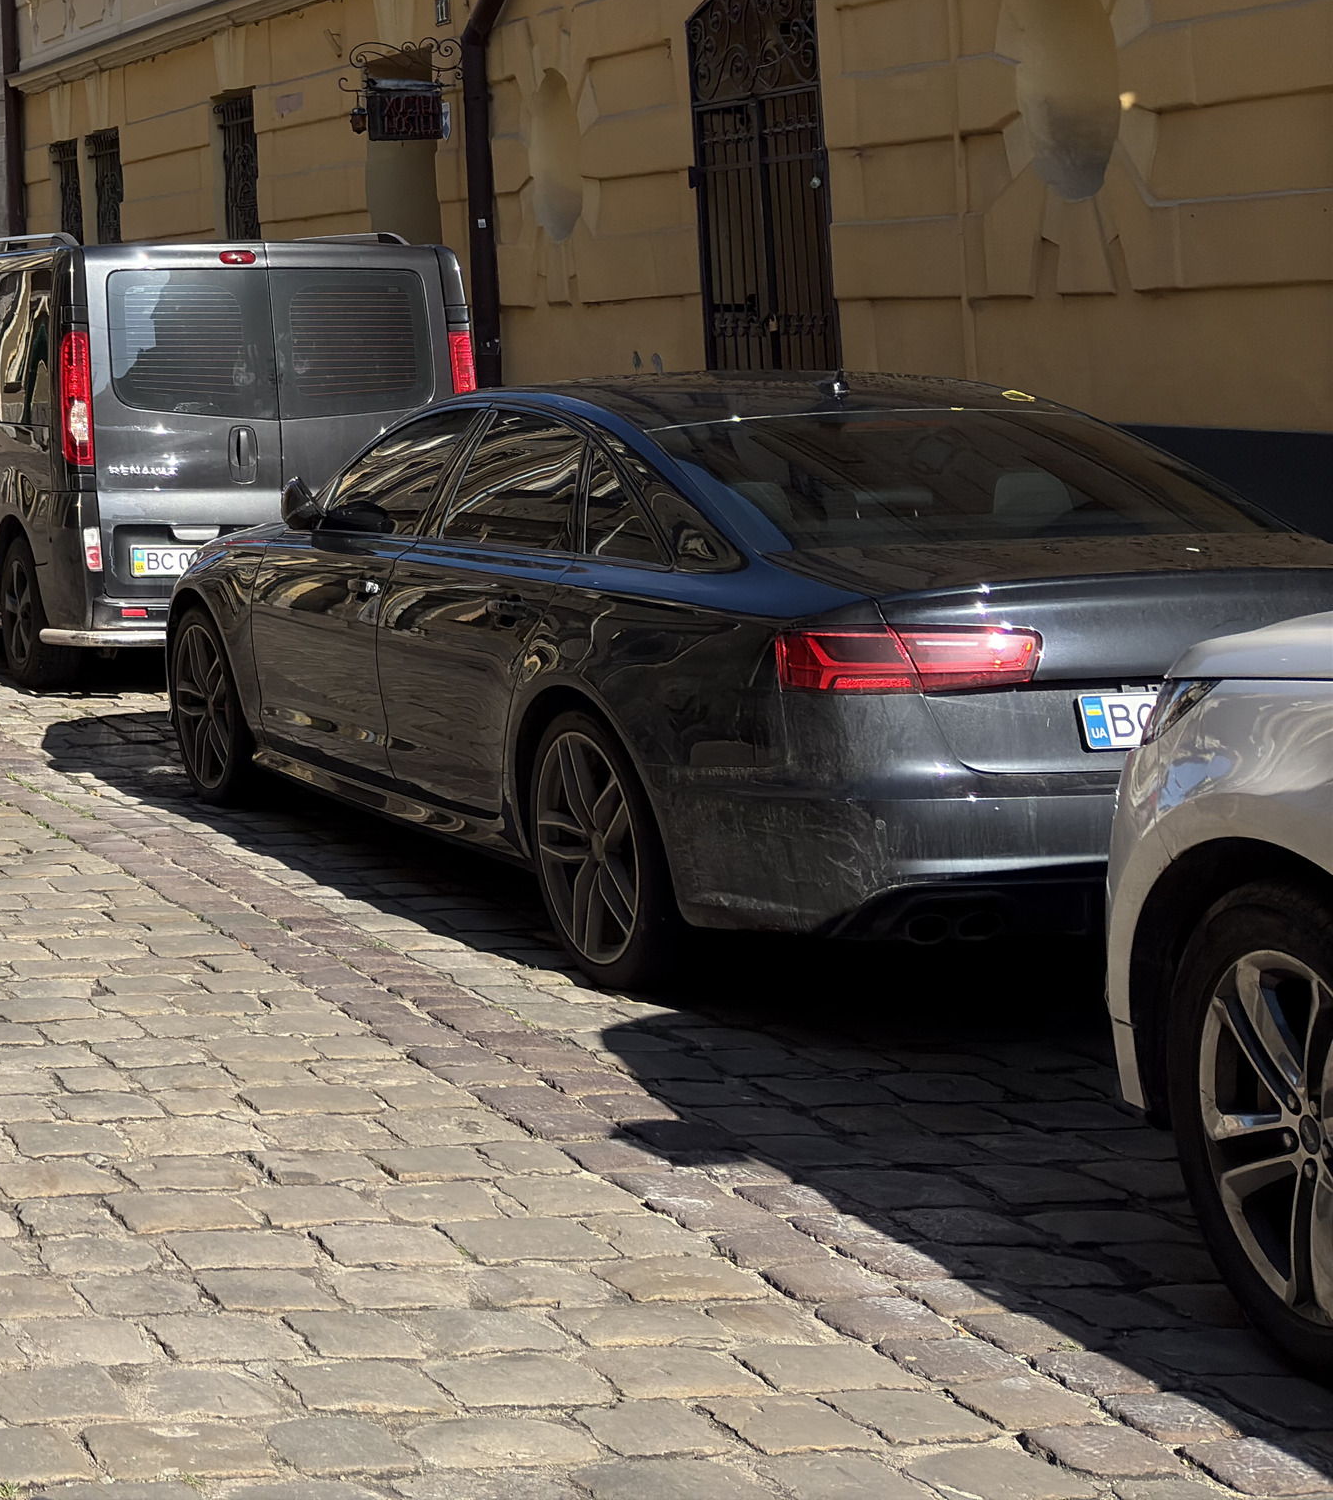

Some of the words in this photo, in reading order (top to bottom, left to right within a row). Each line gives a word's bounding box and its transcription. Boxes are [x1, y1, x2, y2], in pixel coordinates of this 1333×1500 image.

[437, 0, 447, 21] 11
[384, 114, 441, 135] HOSTEL
[108, 464, 178, 477] RENAULT
[147, 553, 174, 570] BC
[1091, 727, 1108, 738] UA
